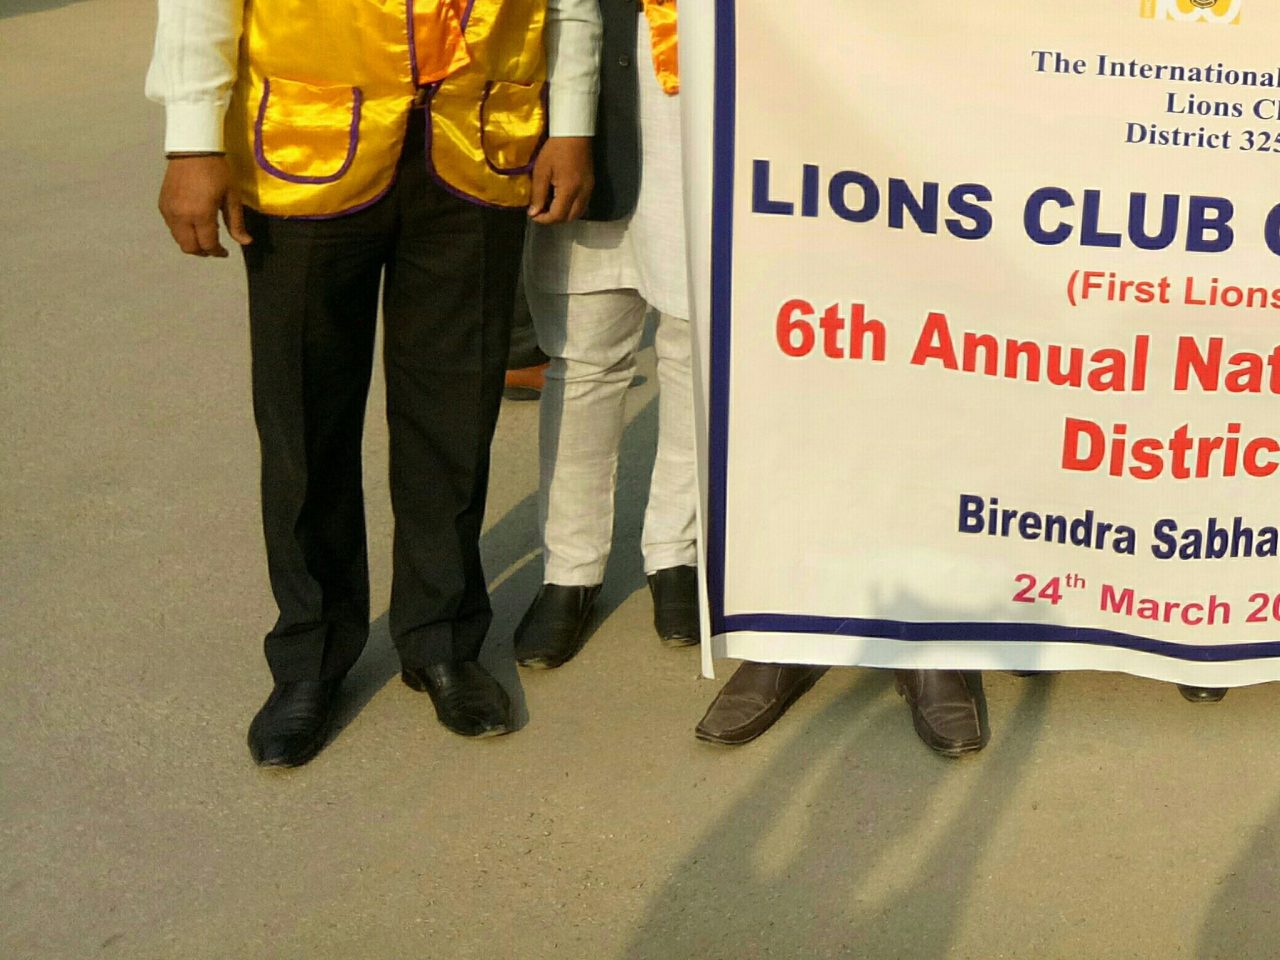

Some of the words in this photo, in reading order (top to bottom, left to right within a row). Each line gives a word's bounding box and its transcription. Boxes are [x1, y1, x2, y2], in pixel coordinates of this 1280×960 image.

[1032, 51, 1086, 75] The
[1166, 92, 1243, 118] Lions
[1126, 122, 1231, 149] District
[751, 159, 993, 240] LIONS
[1023, 186, 1234, 253] CLUB
[1067, 271, 1170, 306] (First
[776, 299, 887, 362] 6th
[911, 312, 1146, 392] Annual
[958, 494, 1136, 556] Birendra
[1013, 573, 1086, 605] 24th
[1100, 584, 1231, 626] March
